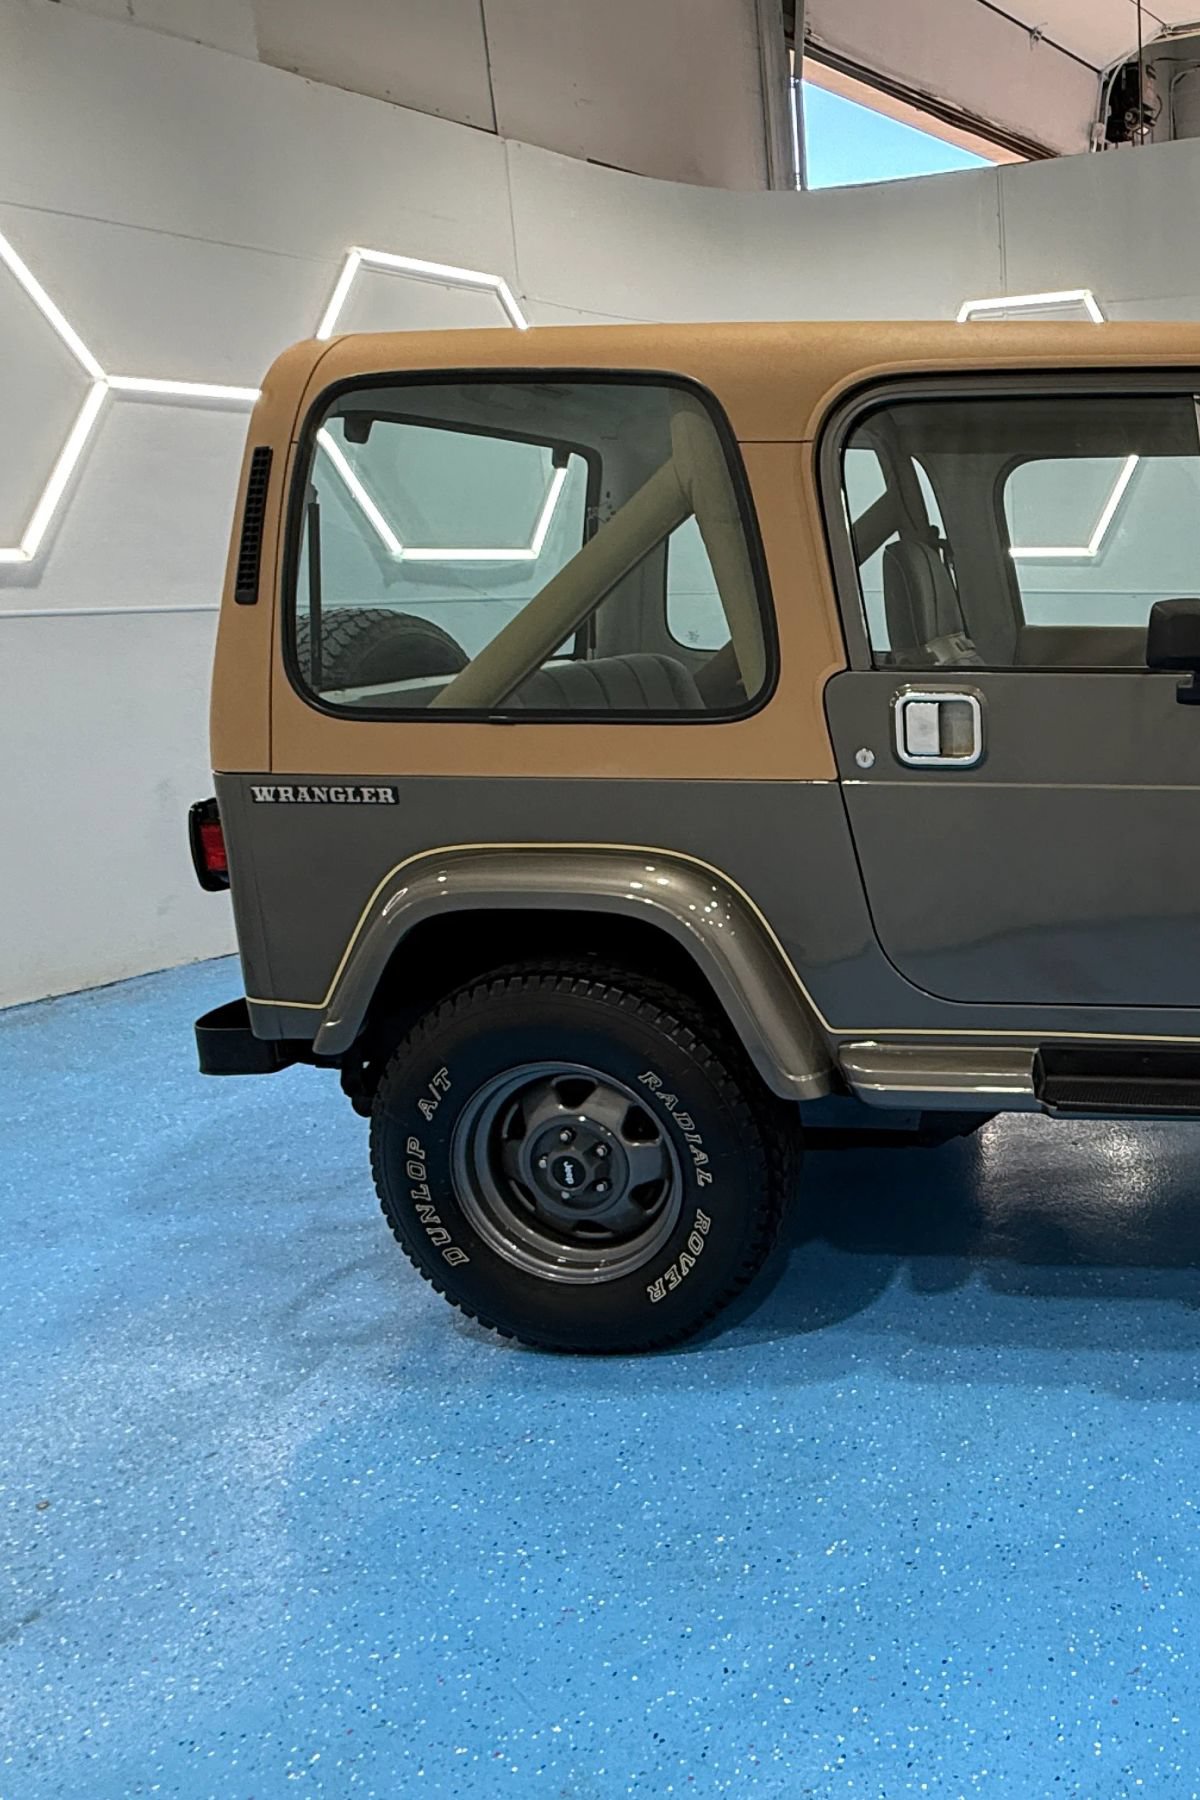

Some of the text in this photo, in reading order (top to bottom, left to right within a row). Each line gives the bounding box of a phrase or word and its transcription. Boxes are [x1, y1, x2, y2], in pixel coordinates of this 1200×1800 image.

[251, 786, 396, 803] WRANGLER
[407, 1067, 470, 1267] DUNLOP A/T
[563, 1161, 574, 1184] Jeep
[638, 1070, 713, 1302] RADIAL ROVER
